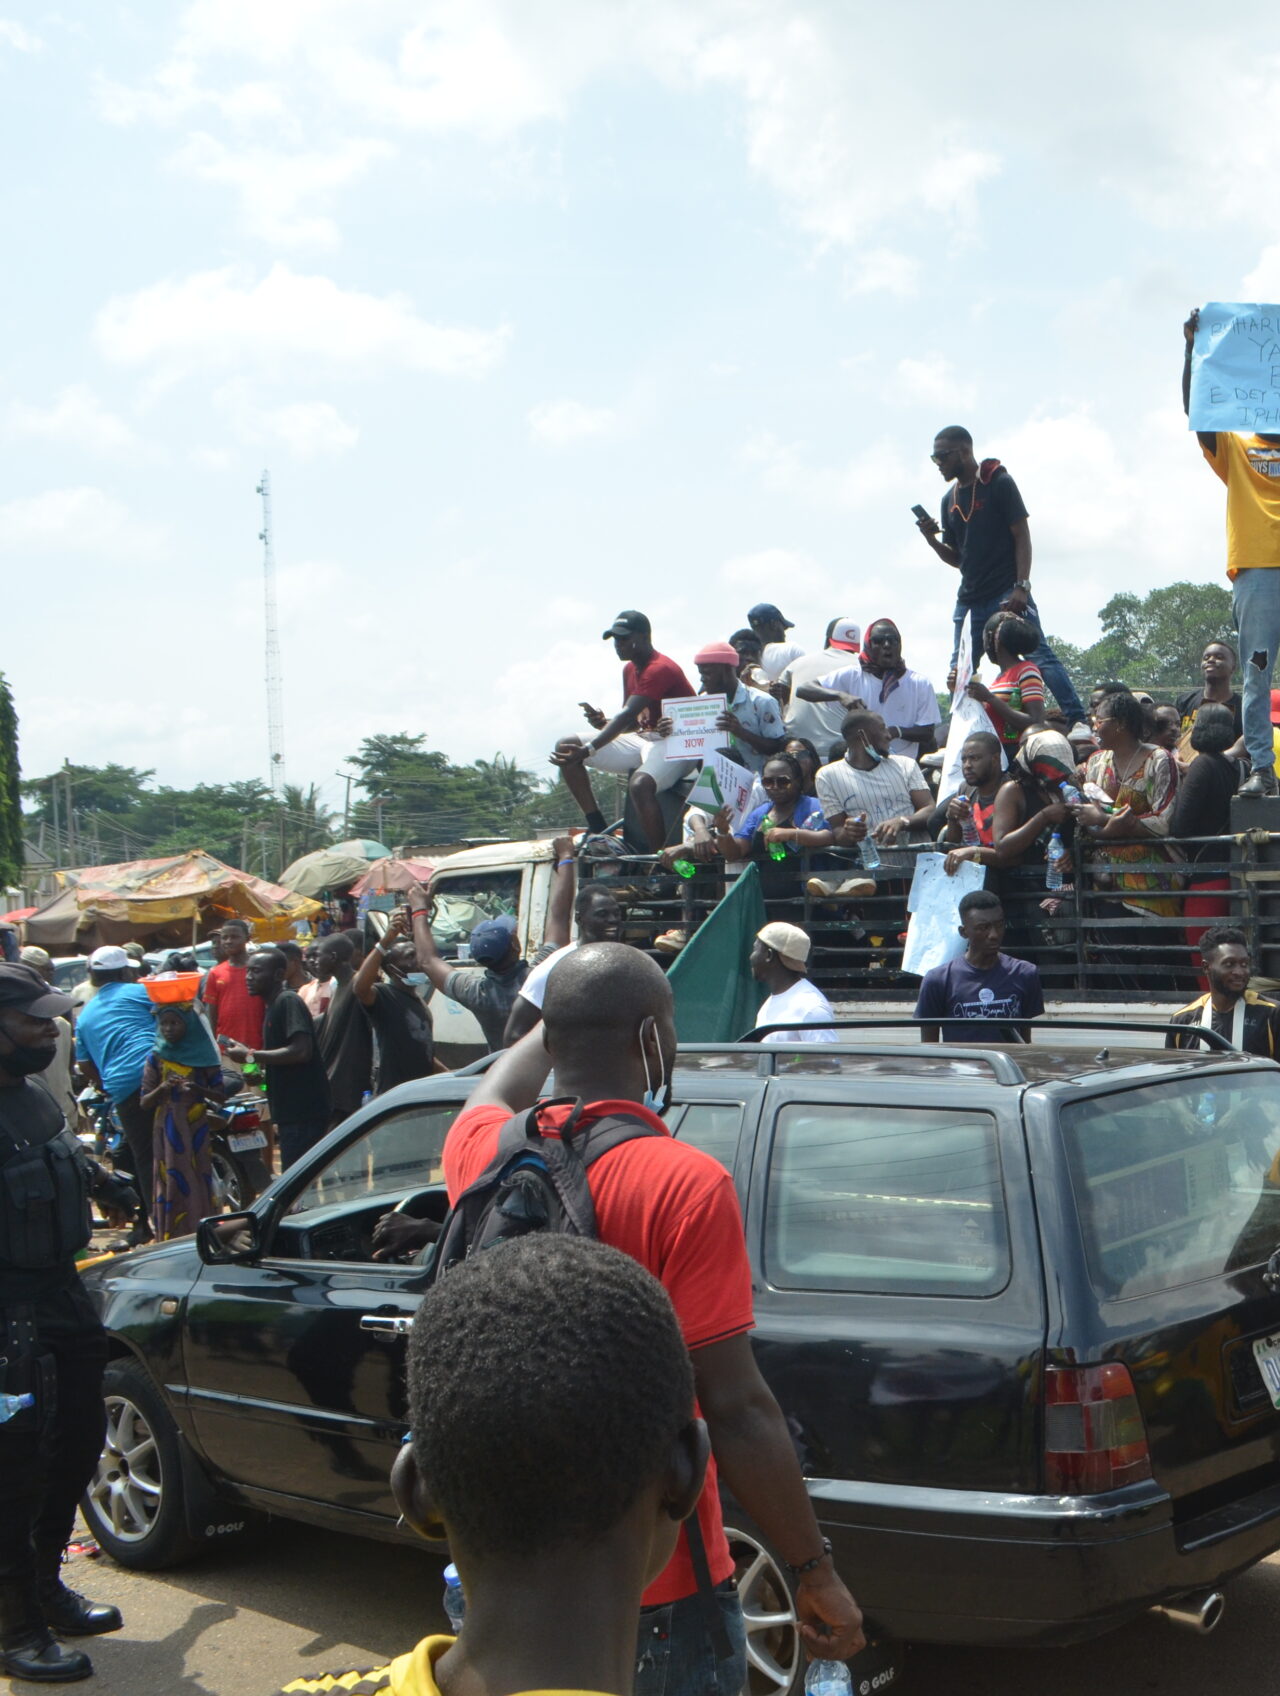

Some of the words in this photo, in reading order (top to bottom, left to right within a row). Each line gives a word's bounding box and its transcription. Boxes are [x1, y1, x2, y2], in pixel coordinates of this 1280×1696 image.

[1210, 386, 1226, 404] E
[1234, 387, 1267, 403] DEY
[684, 738, 705, 749] NOW
[217, 1521, 245, 1535] GOLF
[872, 1667, 895, 1689] GOLF
